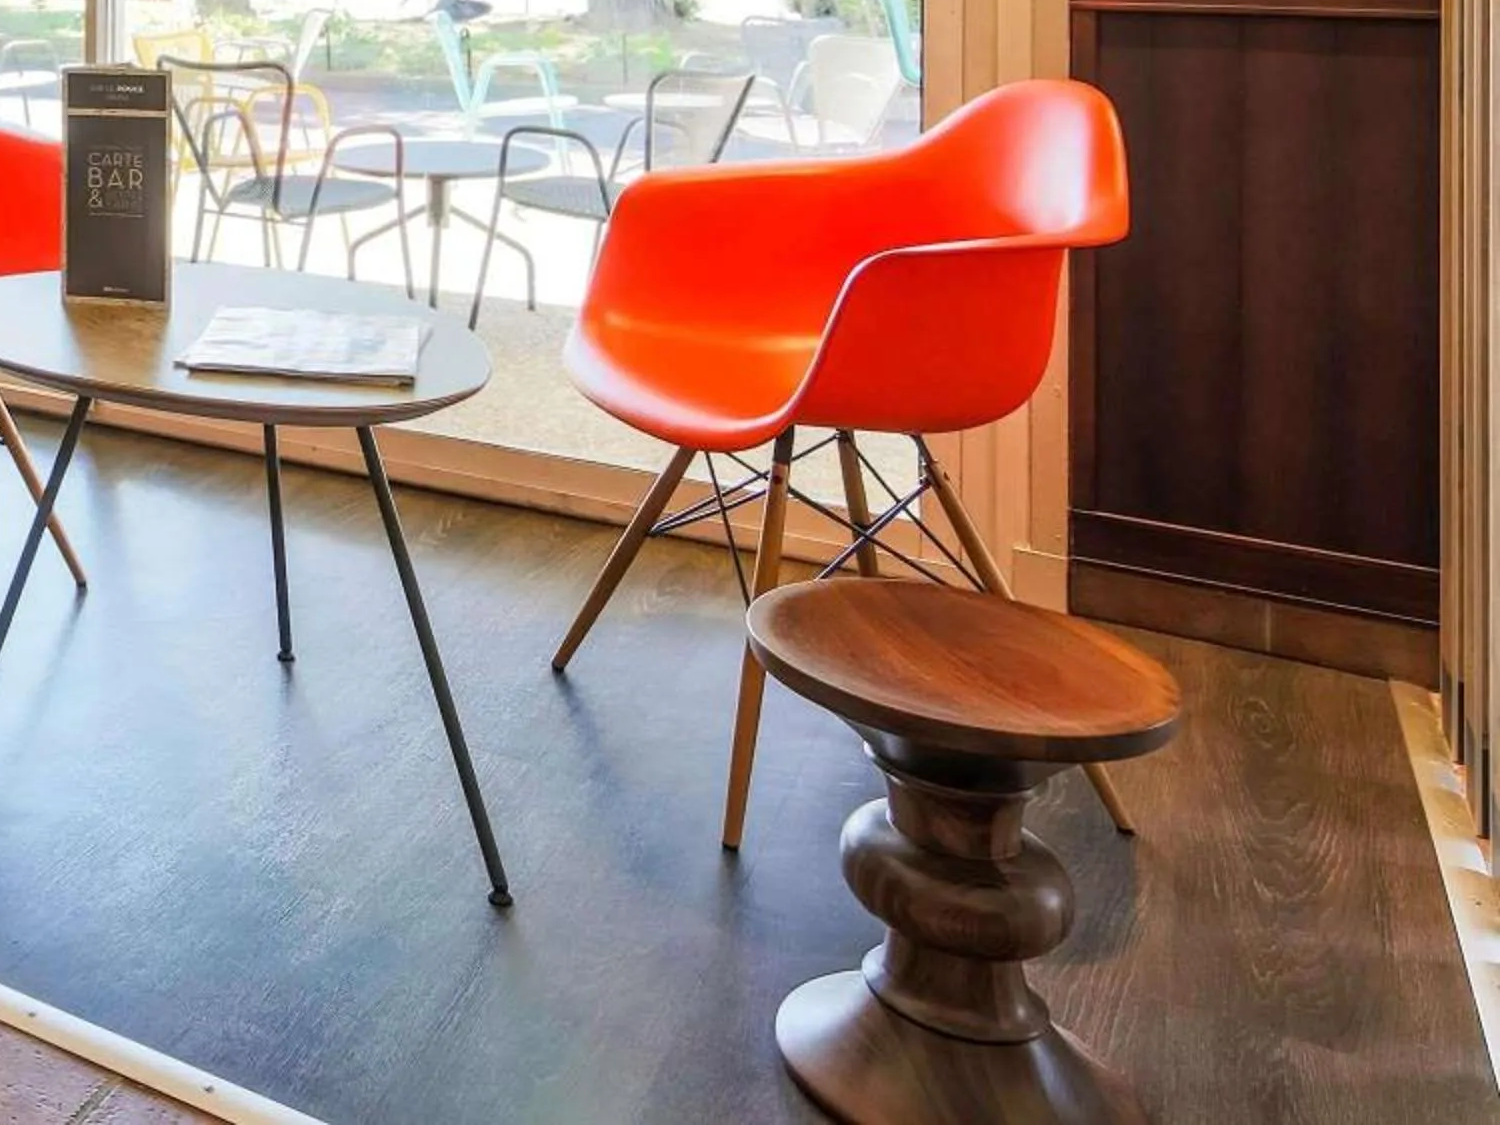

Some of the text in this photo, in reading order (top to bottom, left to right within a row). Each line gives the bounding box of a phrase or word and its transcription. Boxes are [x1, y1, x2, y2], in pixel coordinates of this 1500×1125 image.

[88, 152, 143, 168] CARTE
[88, 166, 143, 190] BAR
[88, 188, 102, 208] &
